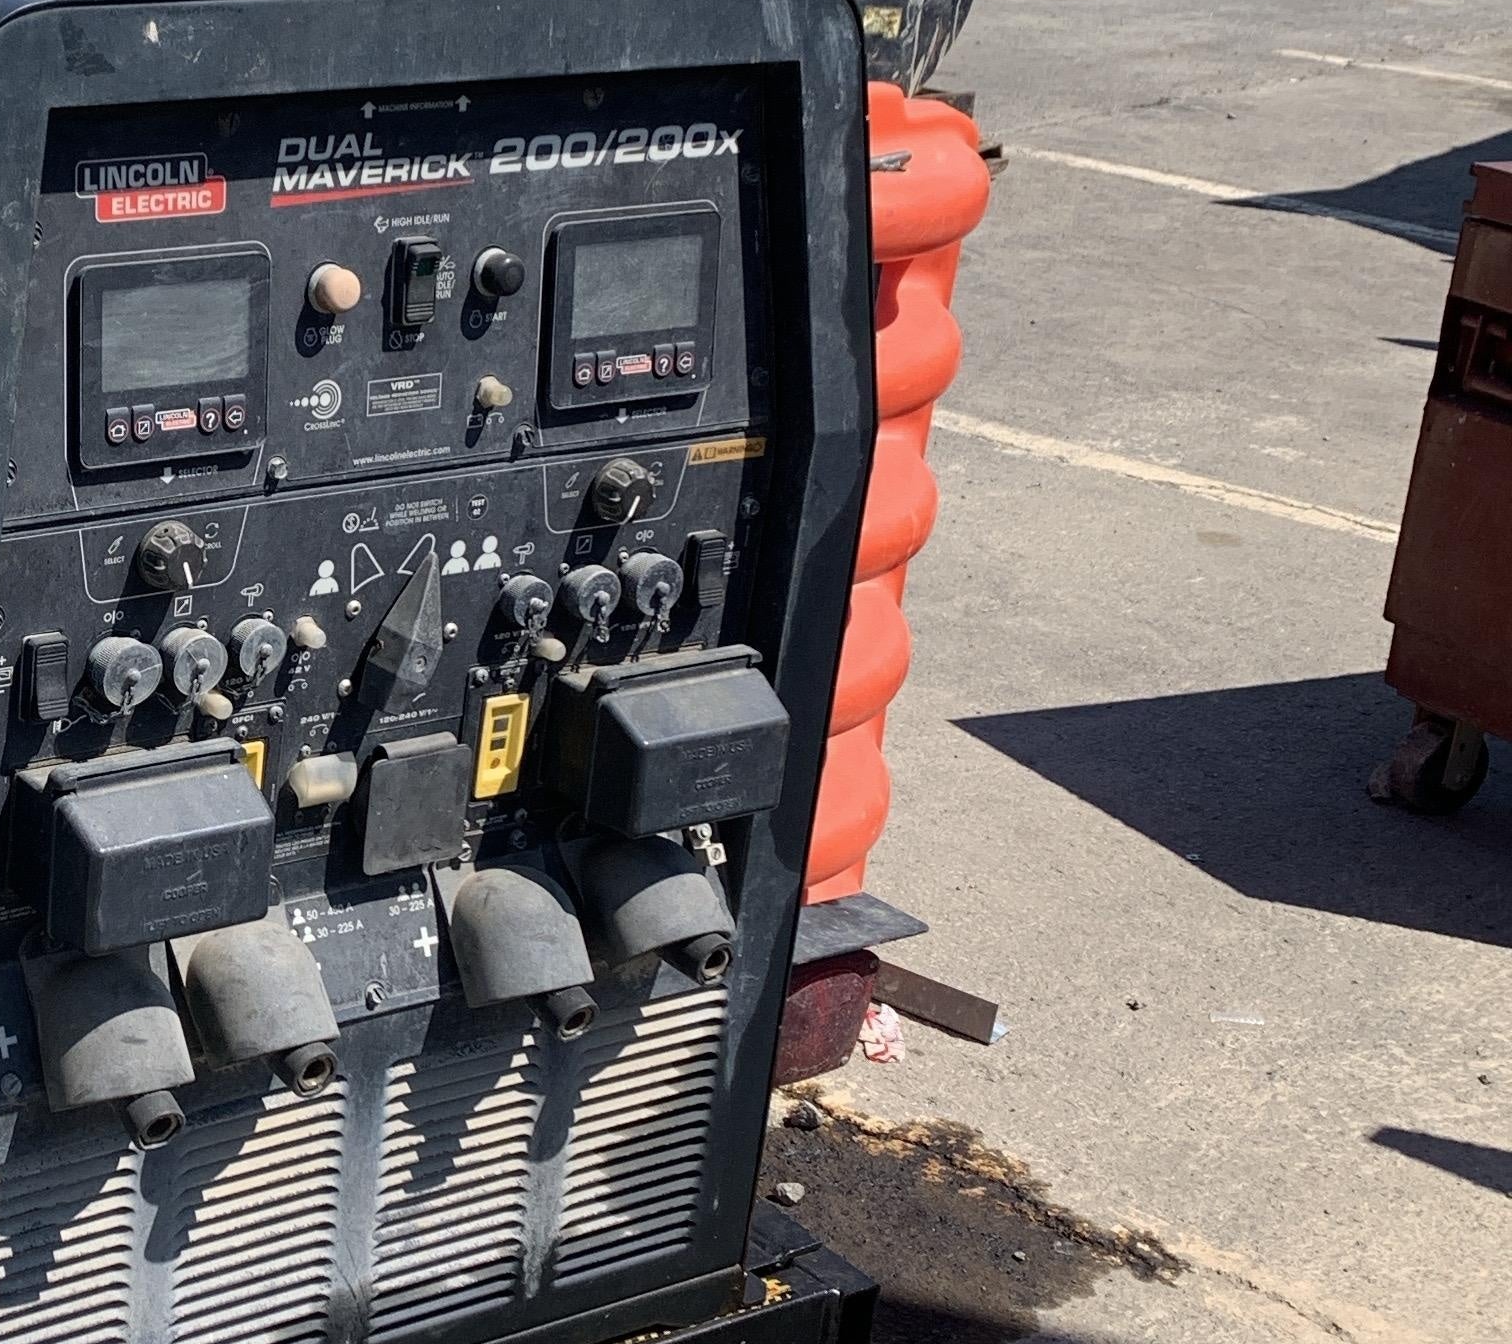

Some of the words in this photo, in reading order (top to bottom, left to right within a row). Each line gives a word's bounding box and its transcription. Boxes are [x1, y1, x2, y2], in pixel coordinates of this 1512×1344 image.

[277, 131, 383, 164] DUAL
[84, 159, 200, 192] LINCOLN
[271, 153, 473, 193] MAVERICK
[111, 189, 213, 216] ELECTRIC
[391, 216, 413, 227] HIGH
[413, 213, 451, 226] IDLE/RUN
[485, 311, 508, 323] START
[319, 324, 346, 336] GLOW
[321, 334, 343, 346] PLUG
[404, 332, 425, 344] STOP
[390, 380, 414, 391] VRD
[352, 446, 451, 466] www.lincolnelectric.com
[178, 465, 219, 479] SELECTOR
[205, 541, 222, 550] CROLL
[104, 555, 125, 565] SELECT
[300, 714, 320, 725] 240
[388, 906, 401, 917] 30
[409, 900, 426, 912] 225
[426, 898, 435, 909] A
[305, 909, 319, 921] 50
[316, 926, 329, 939] 30
[337, 922, 355, 935] 225
[356, 919, 365, 931] A
